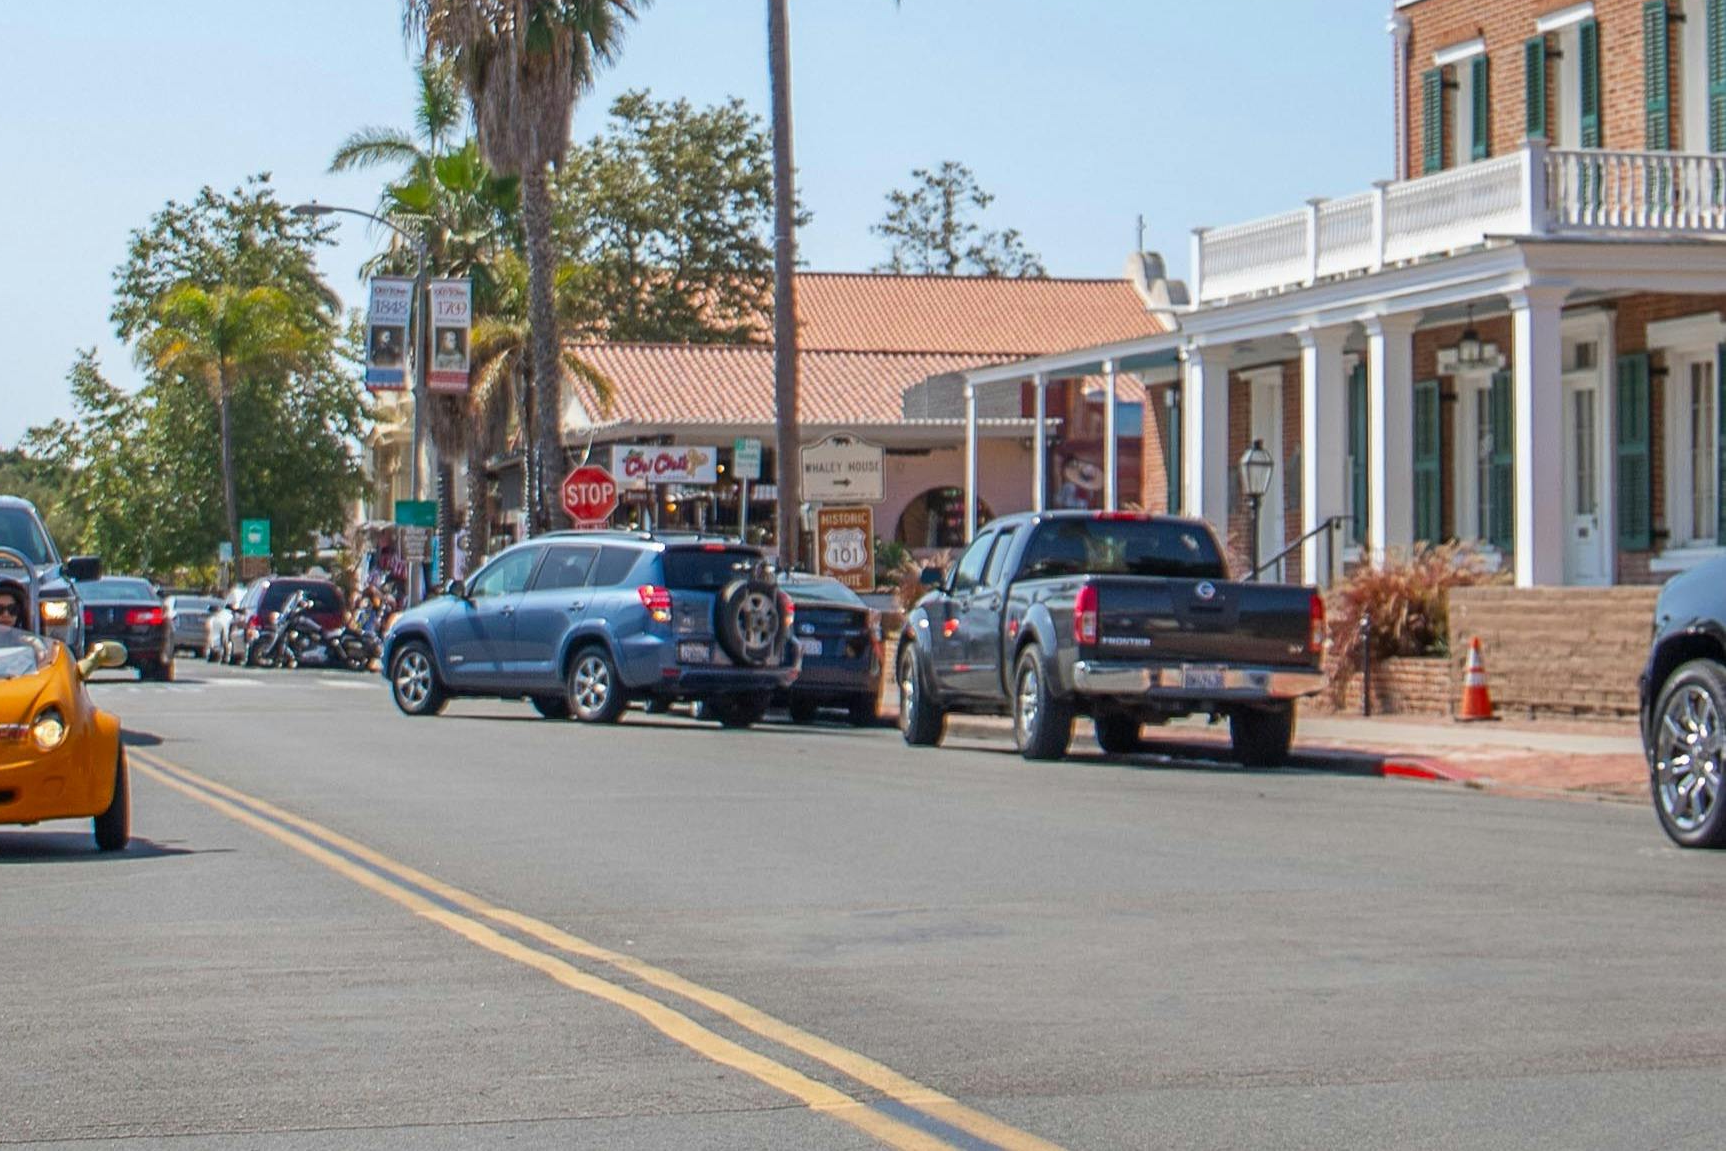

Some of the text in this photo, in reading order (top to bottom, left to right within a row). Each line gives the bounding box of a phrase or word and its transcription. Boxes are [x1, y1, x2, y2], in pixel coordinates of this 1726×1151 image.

[375, 300, 407, 315] 1848
[805, 460, 879, 473] WHALEY HOUSE
[567, 482, 614, 507] STOP
[821, 512, 868, 525] HISTORIC
[834, 548, 858, 563] 101
[837, 574, 863, 586] OUTE
[1102, 636, 1152, 647] FRONTIER
